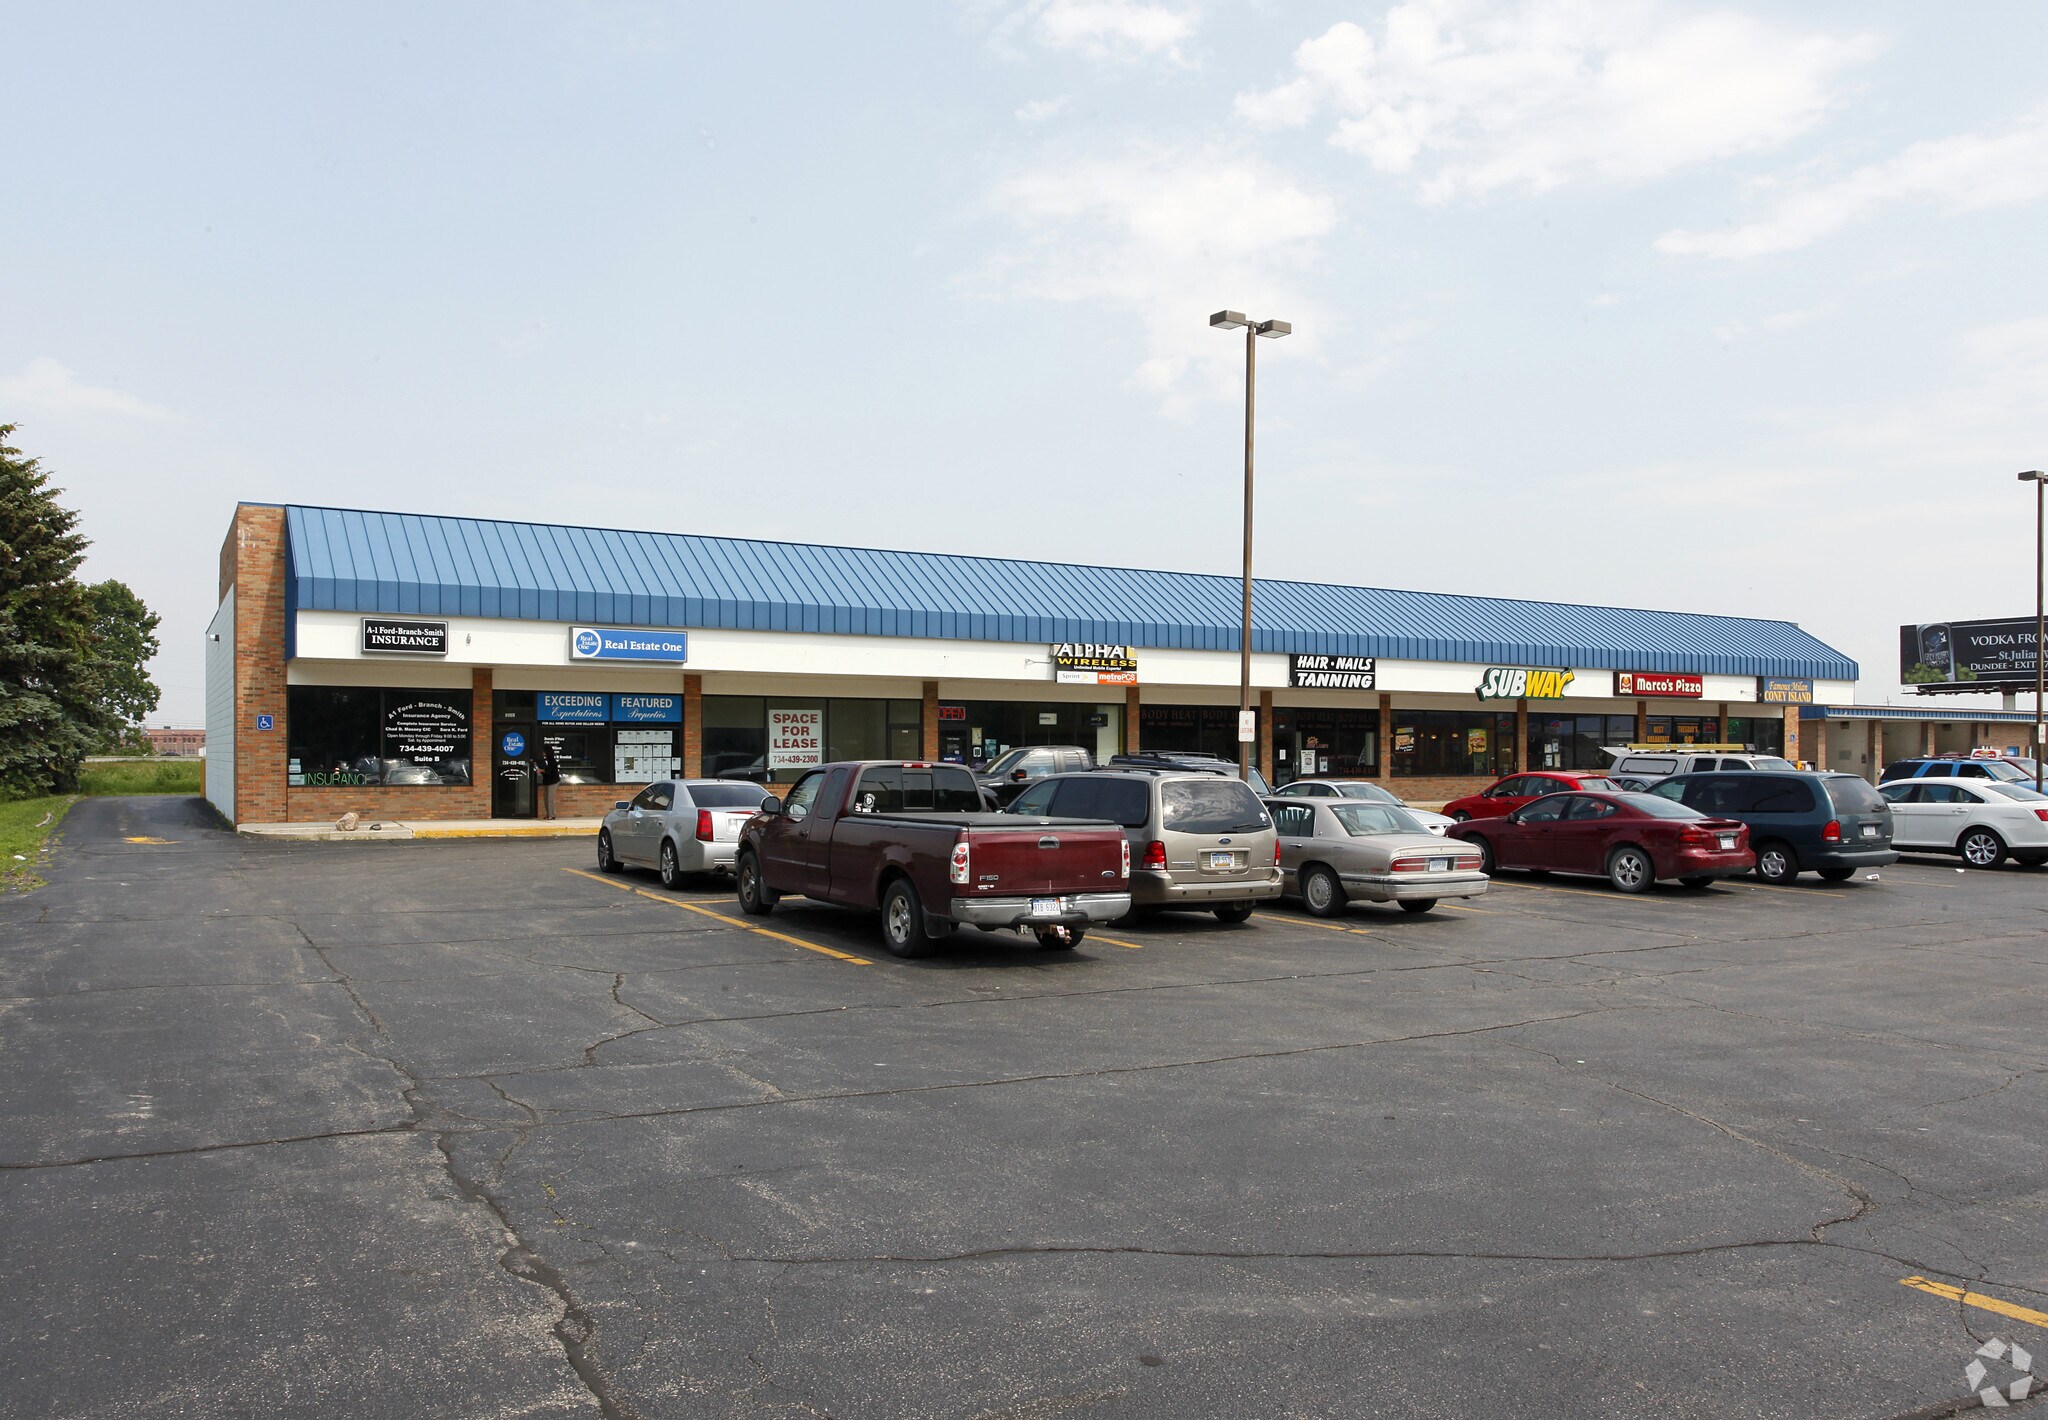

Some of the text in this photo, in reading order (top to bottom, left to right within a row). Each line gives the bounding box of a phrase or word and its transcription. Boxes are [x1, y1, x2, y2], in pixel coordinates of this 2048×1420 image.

[366, 626, 378, 634] A-1
[371, 635, 440, 646] INSURANCE
[604, 639, 682, 652] Real Estate One
[1970, 634, 2015, 646] VODKA
[1057, 643, 1124, 659] ALPHA
[1057, 657, 1136, 667] WIRELESS
[1297, 655, 1372, 671] HAIR NAILS
[1970, 662, 2007, 671] DUNDEE
[2014, 661, 2037, 669] EXIT
[1098, 673, 1135, 681] metroPCS
[1297, 672, 1372, 689] TANNING
[1480, 668, 1574, 699] SUBWAY
[1636, 677, 1702, 693] Marco's Pizza
[1769, 681, 1790, 691] Famous
[544, 695, 602, 707] EXCEEDING
[1764, 690, 1811, 703] CONEY ISLAND
[621, 697, 673, 708] FEATURED
[397, 703, 413, 713] Ford
[447, 706, 466, 720] Smith
[551, 706, 602, 720] Expectations
[627, 709, 666, 721] Properties
[939, 708, 965, 720] OPEN
[1141, 709, 1198, 720] BODY HEAT
[772, 713, 819, 724] SPACE
[781, 726, 810, 736] FOR
[1653, 725, 1664, 734] BEST
[773, 738, 818, 749] LEASE
[773, 755, 819, 763] 734-439-2300
